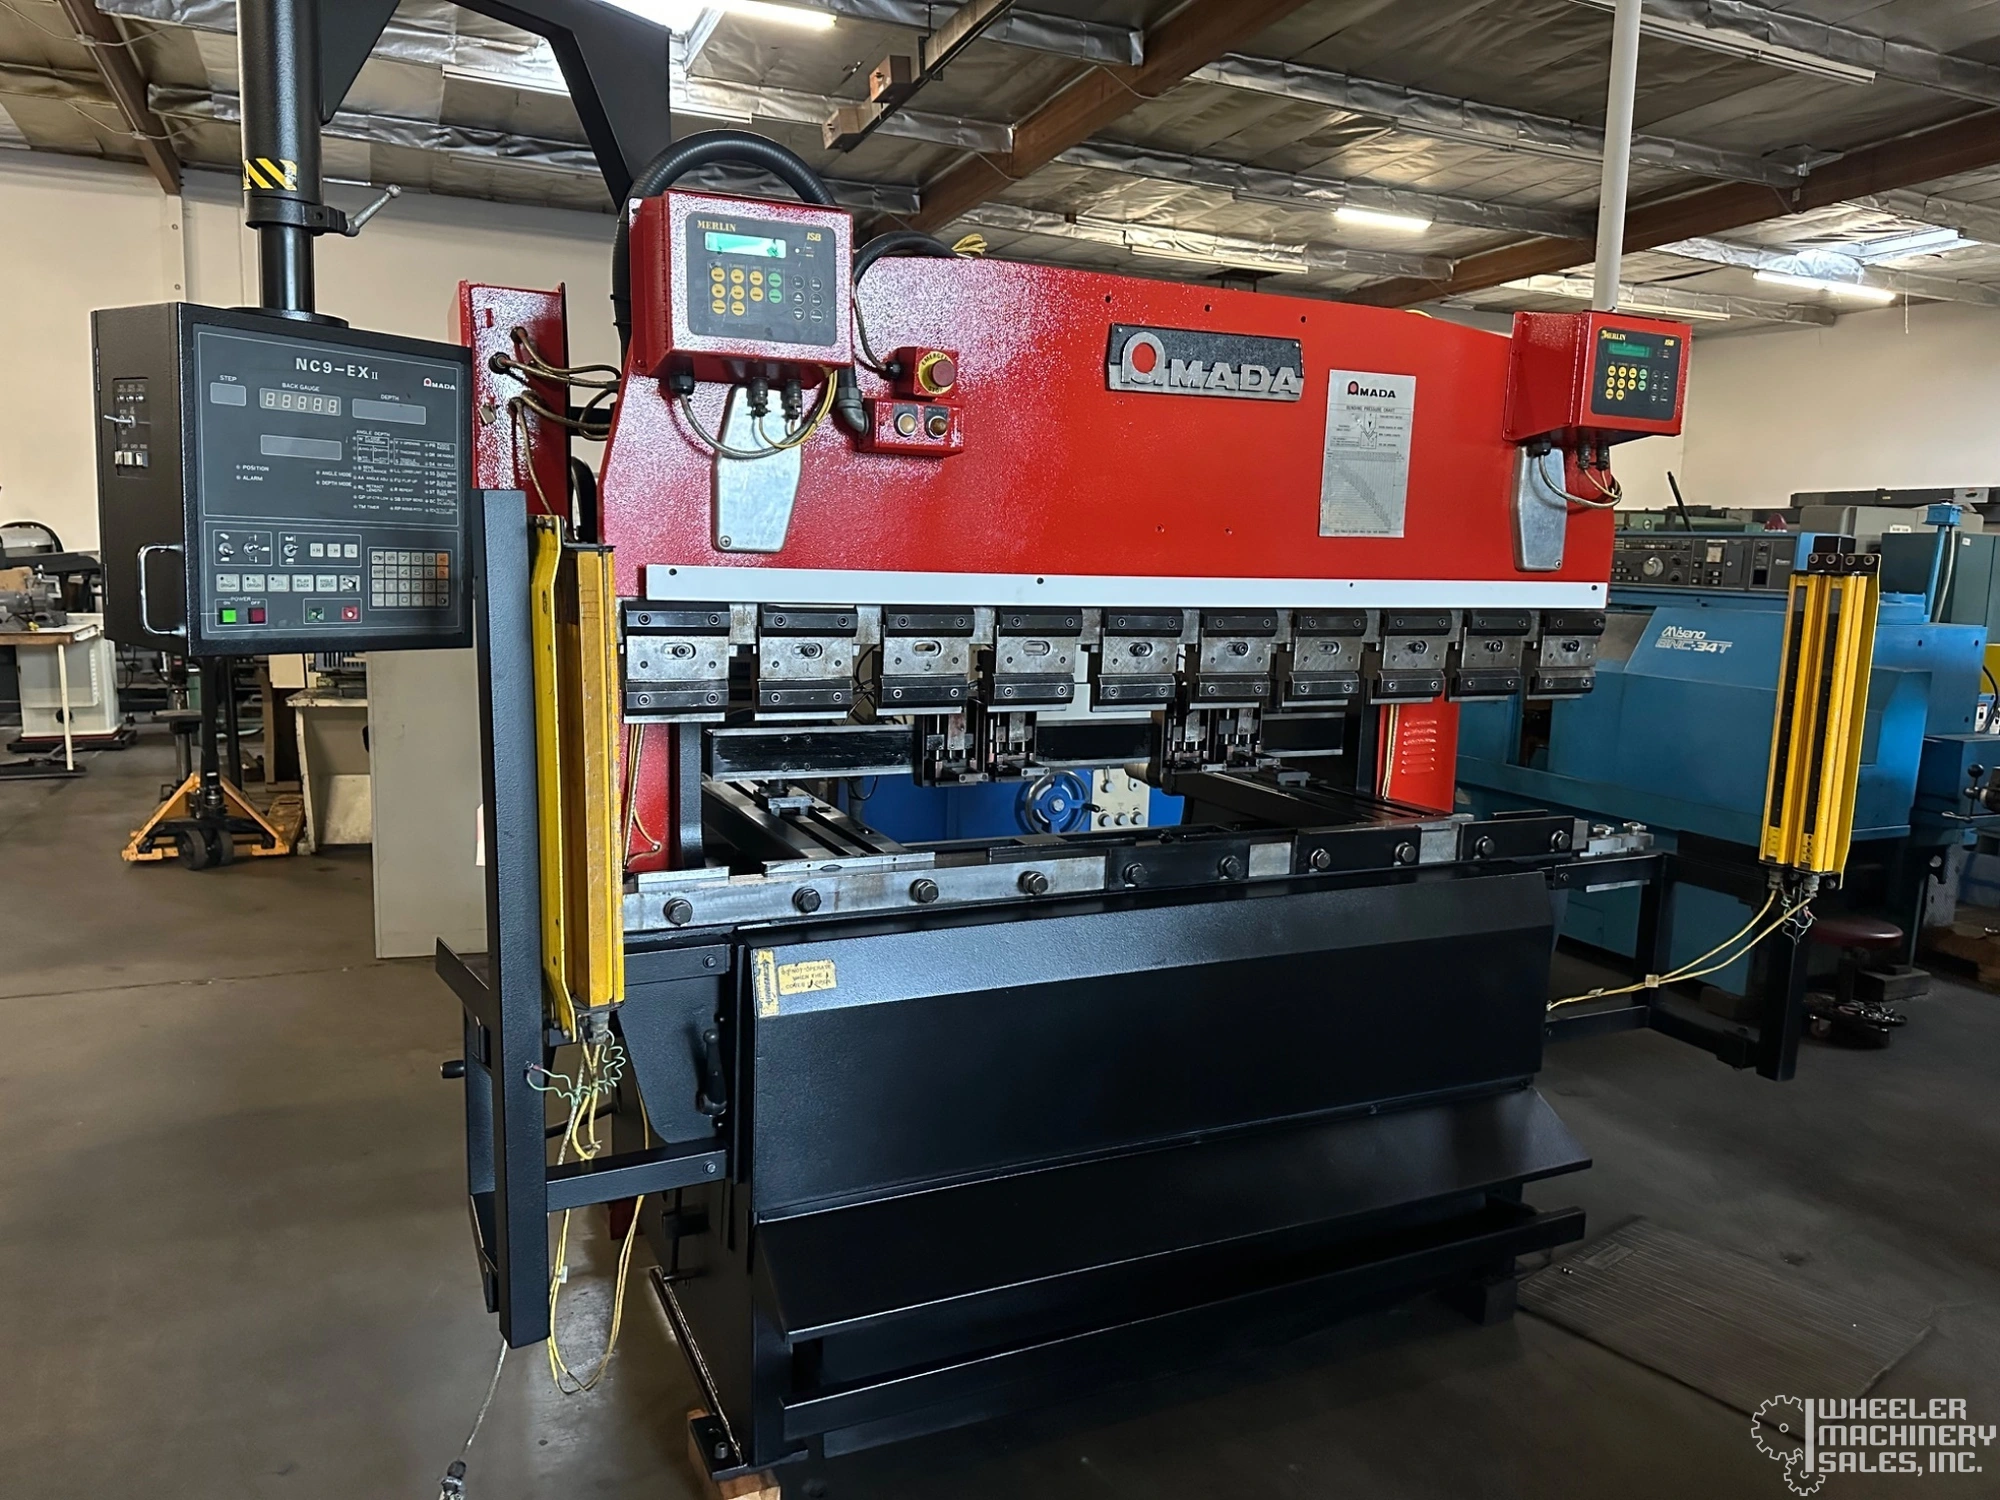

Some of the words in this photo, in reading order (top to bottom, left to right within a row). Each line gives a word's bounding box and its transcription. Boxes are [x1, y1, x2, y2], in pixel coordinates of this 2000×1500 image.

[697, 220, 736, 232] MERLIN
[806, 232, 821, 242] ISB
[1120, 331, 1300, 395] AMADA
[282, 382, 299, 390] BACK
[300, 384, 320, 392] GAUGE
[423, 378, 456, 391] AMADA
[1347, 381, 1396, 398] AMADA
[1661, 625, 1706, 639] Miyano
[1655, 638, 1733, 654] BNC-34T
